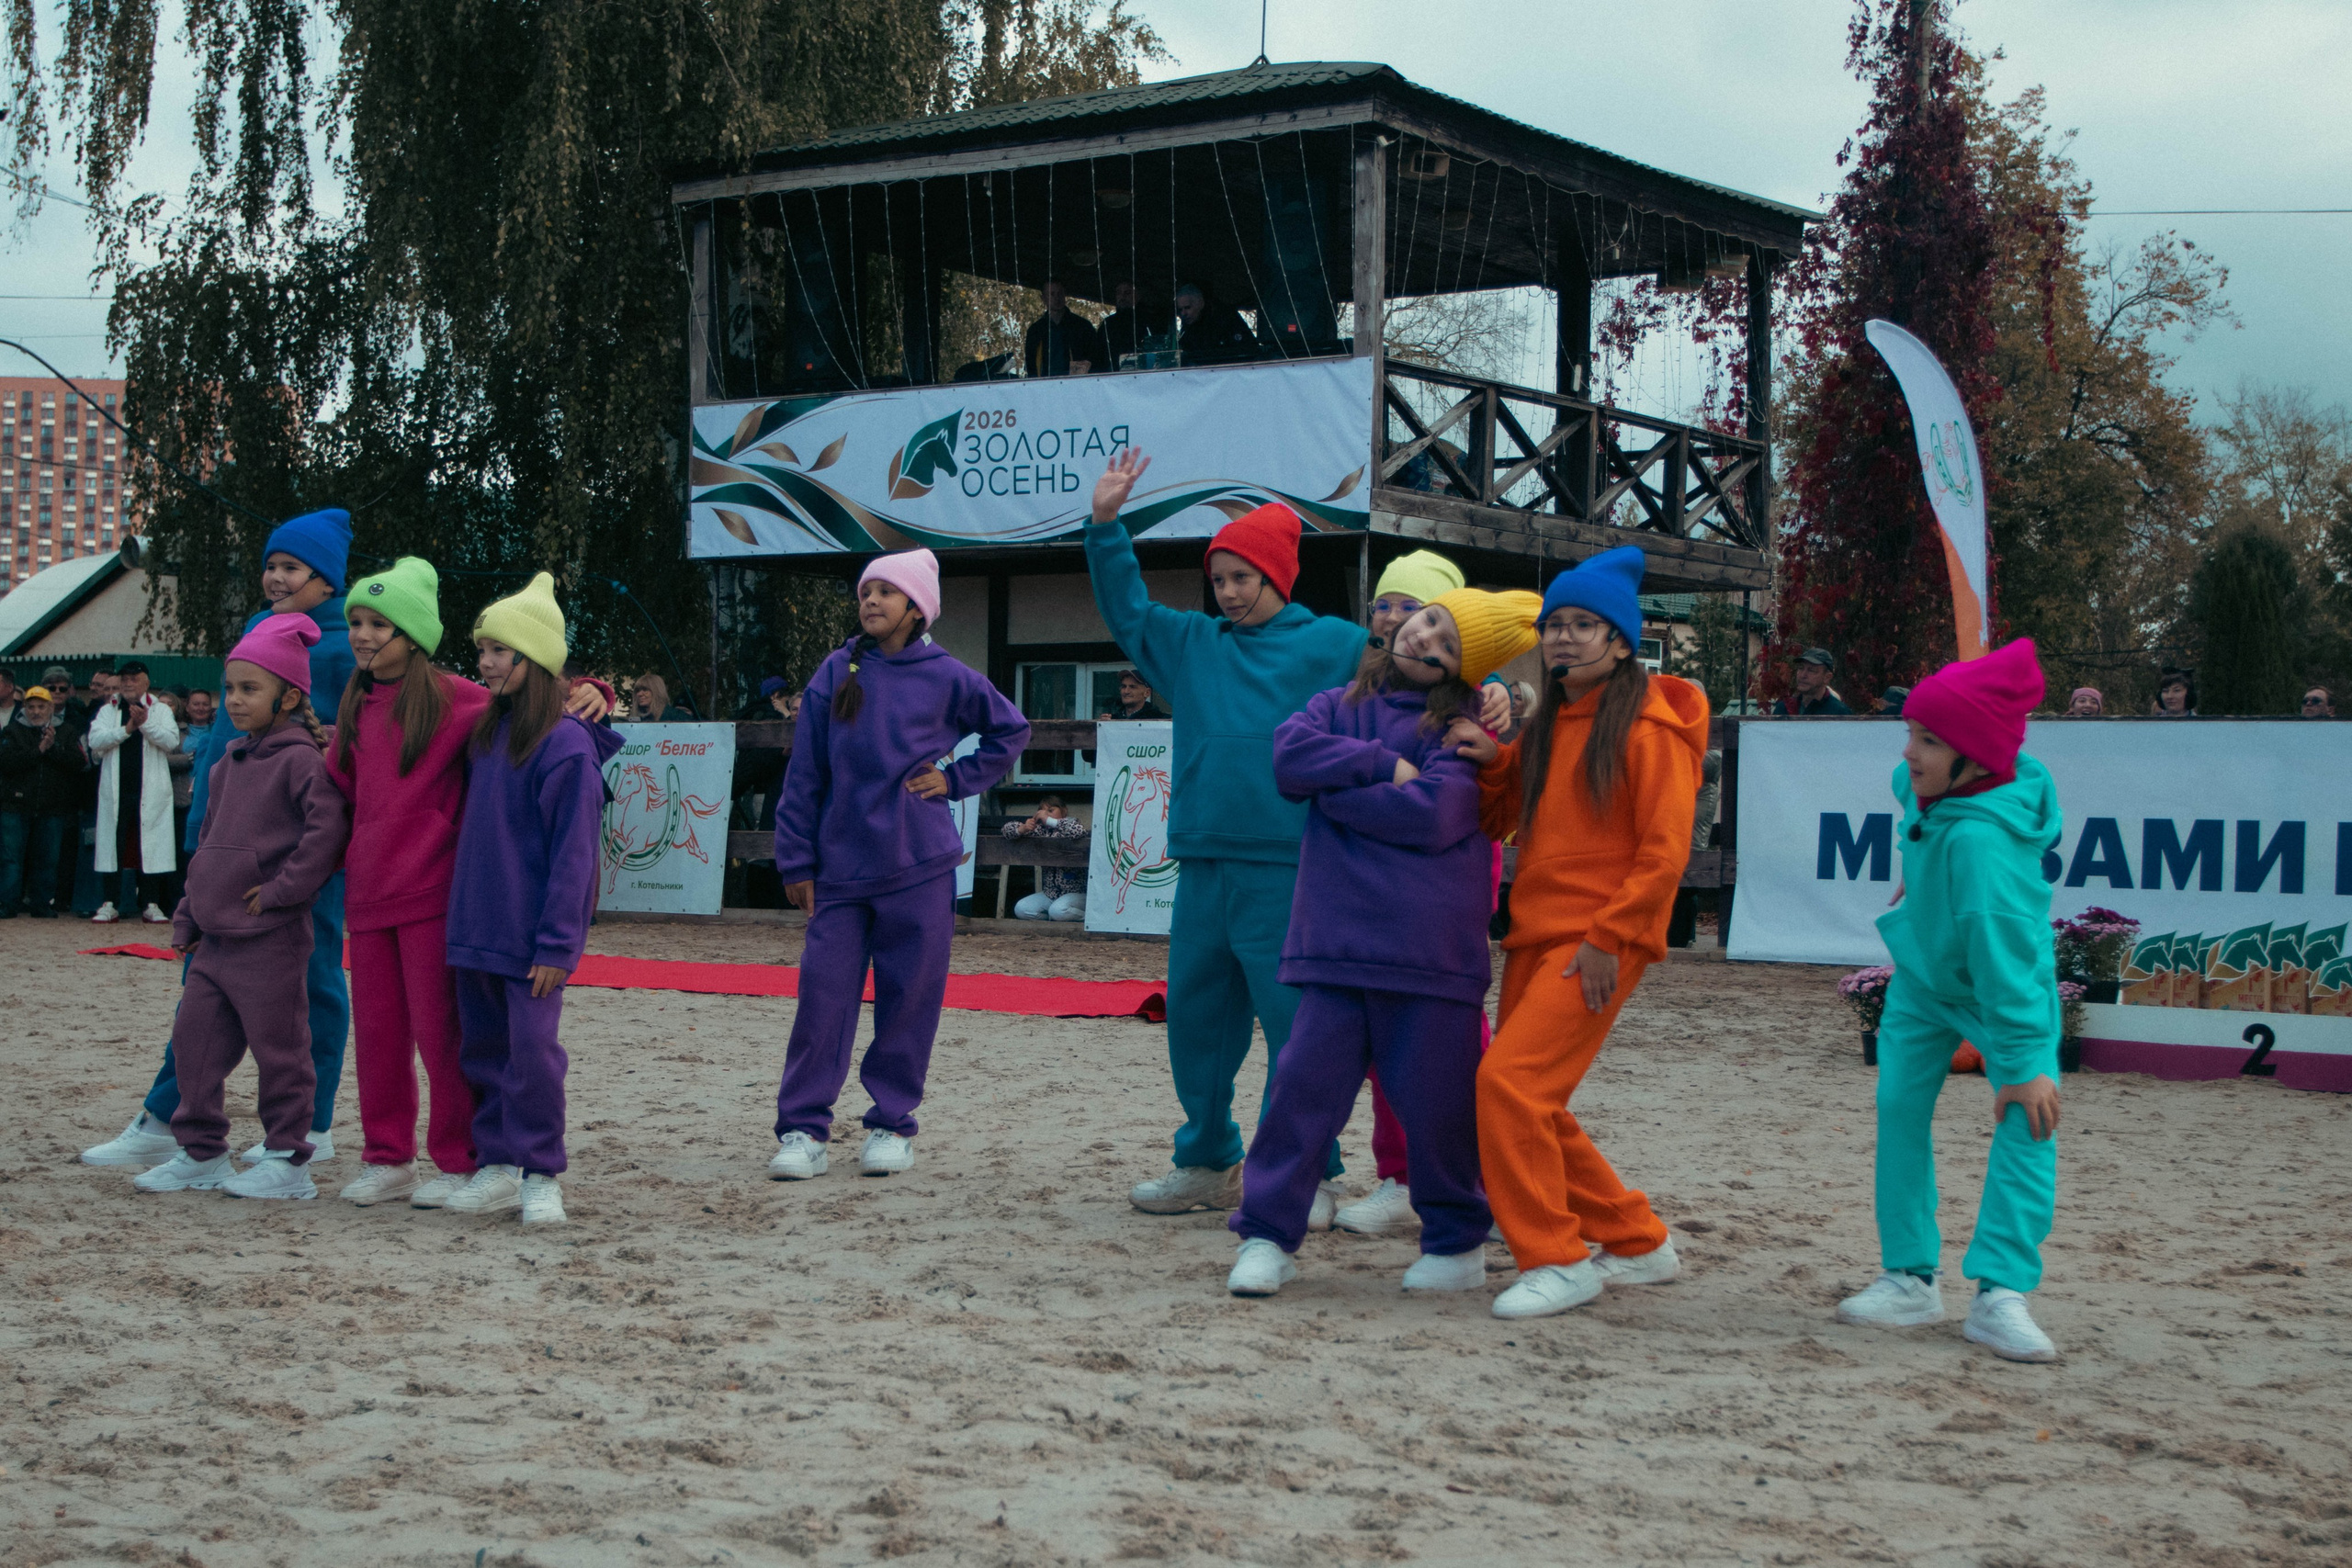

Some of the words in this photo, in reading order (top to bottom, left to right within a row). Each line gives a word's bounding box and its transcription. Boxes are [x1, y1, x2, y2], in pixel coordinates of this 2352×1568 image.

[965, 409, 1017, 431] 2026
[964, 424, 1129, 464] ЗОЛОТАЯ
[961, 463, 1080, 498] ОСЕНЬ
[1126, 745, 1167, 758] СШОР
[638, 880, 684, 890] Котельники
[1154, 898, 1175, 908] Коте
[2239, 1022, 2277, 1077] 2
